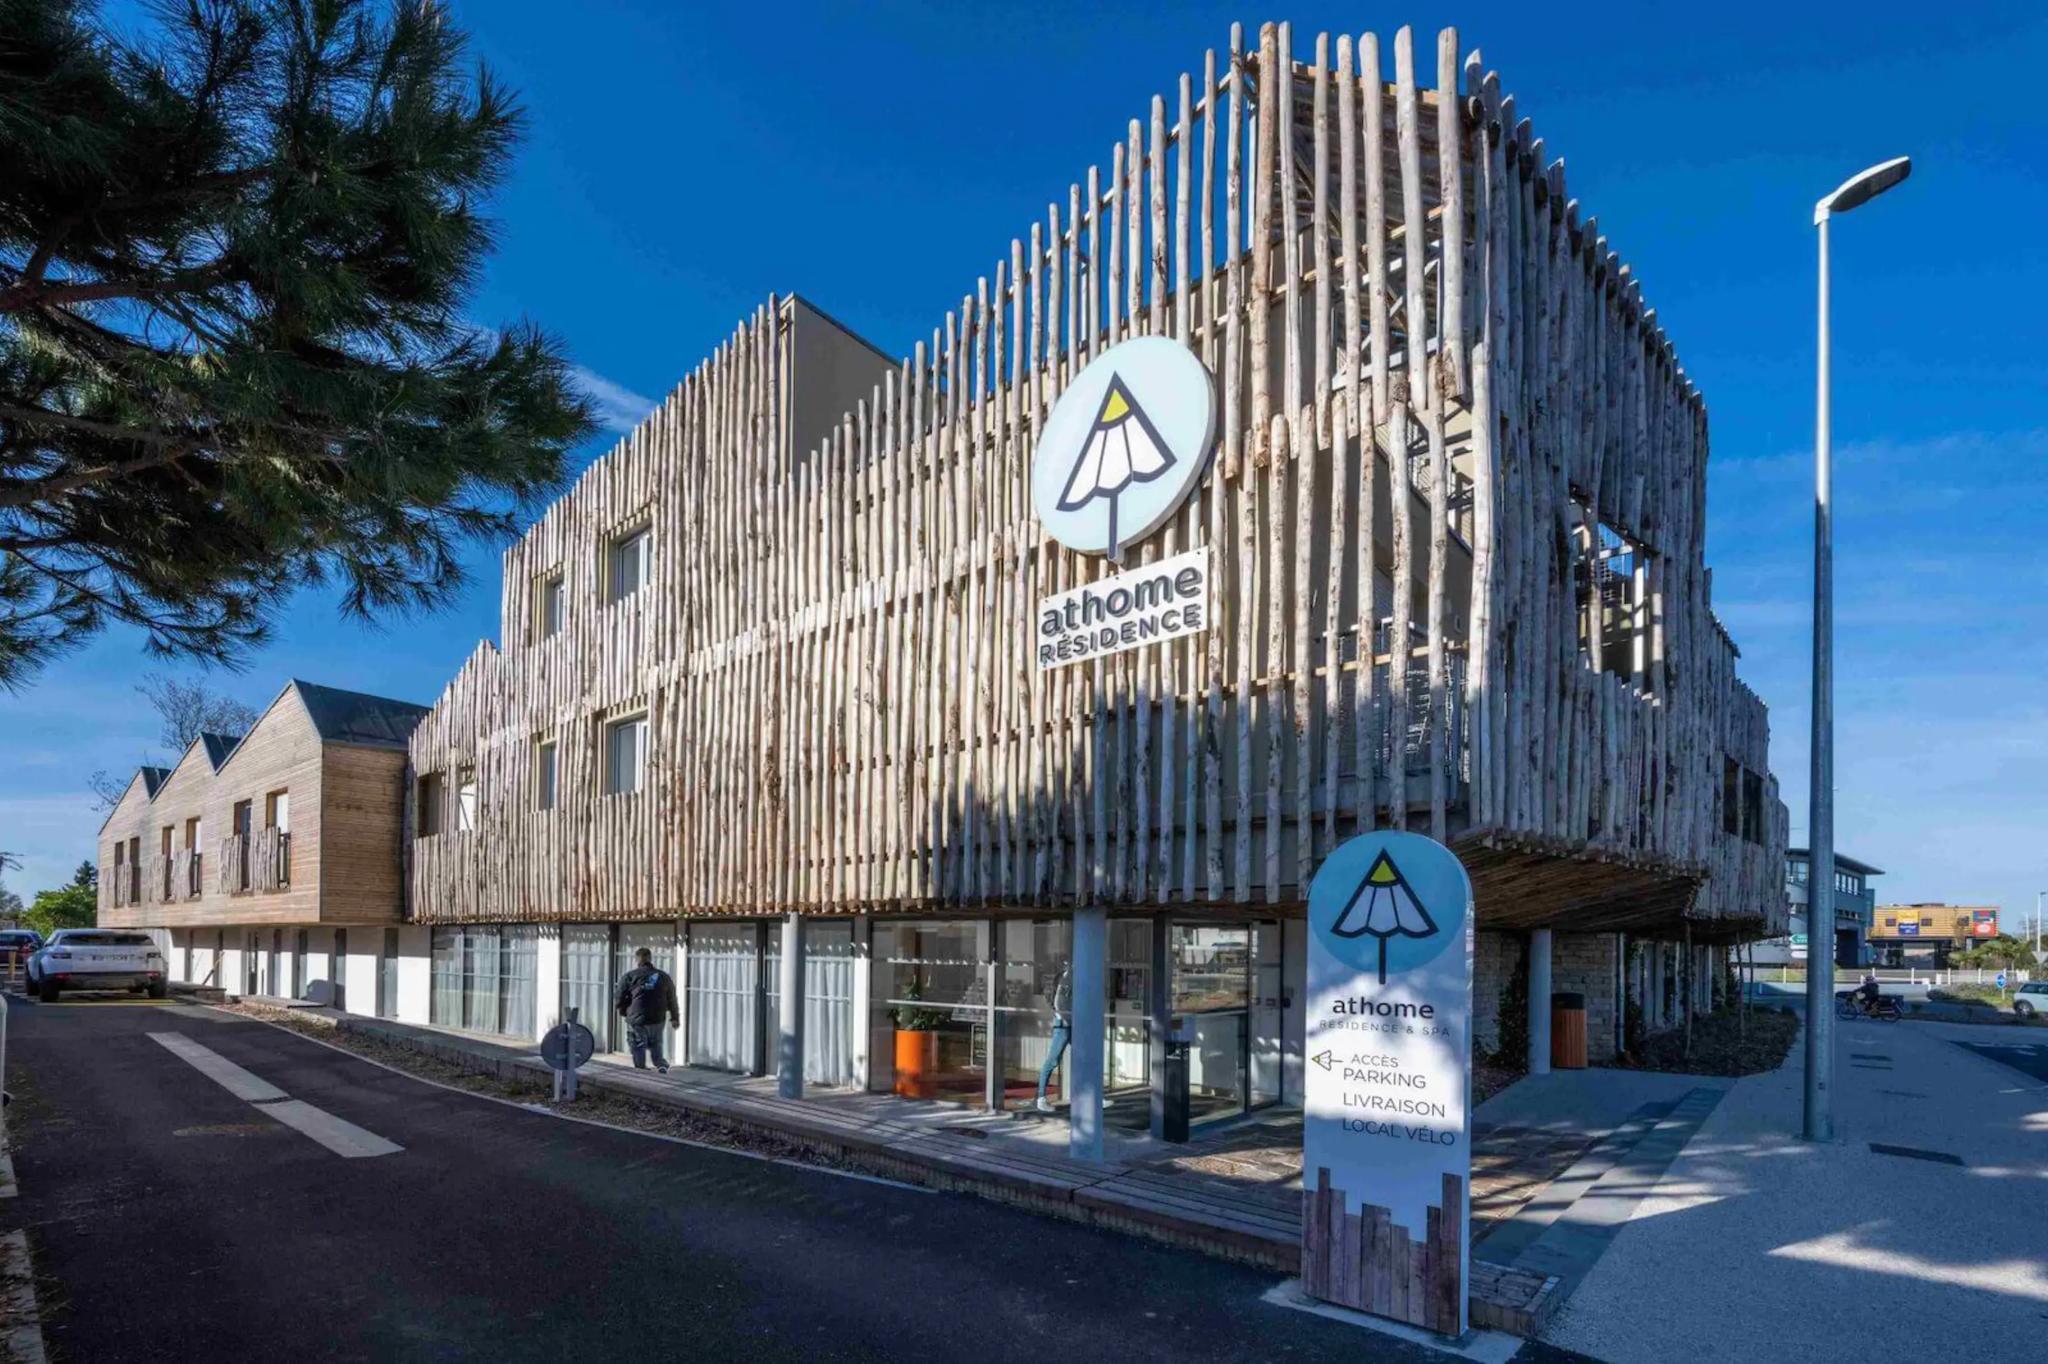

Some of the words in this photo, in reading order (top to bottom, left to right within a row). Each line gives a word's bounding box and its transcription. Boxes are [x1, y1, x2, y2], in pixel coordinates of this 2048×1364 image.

[1041, 566, 1203, 637] athome
[1039, 603, 1202, 664] RÉSIDENCE
[1332, 996, 1434, 1019] athome
[1422, 1026, 1450, 1037] SPA
[1351, 1053, 1399, 1068] ACCÈS
[1343, 1067, 1426, 1089] PARKING
[1343, 1092, 1445, 1118] LIVRAISON
[1342, 1117, 1401, 1138] LOCAL
[1405, 1125, 1456, 1146] VÉLO
